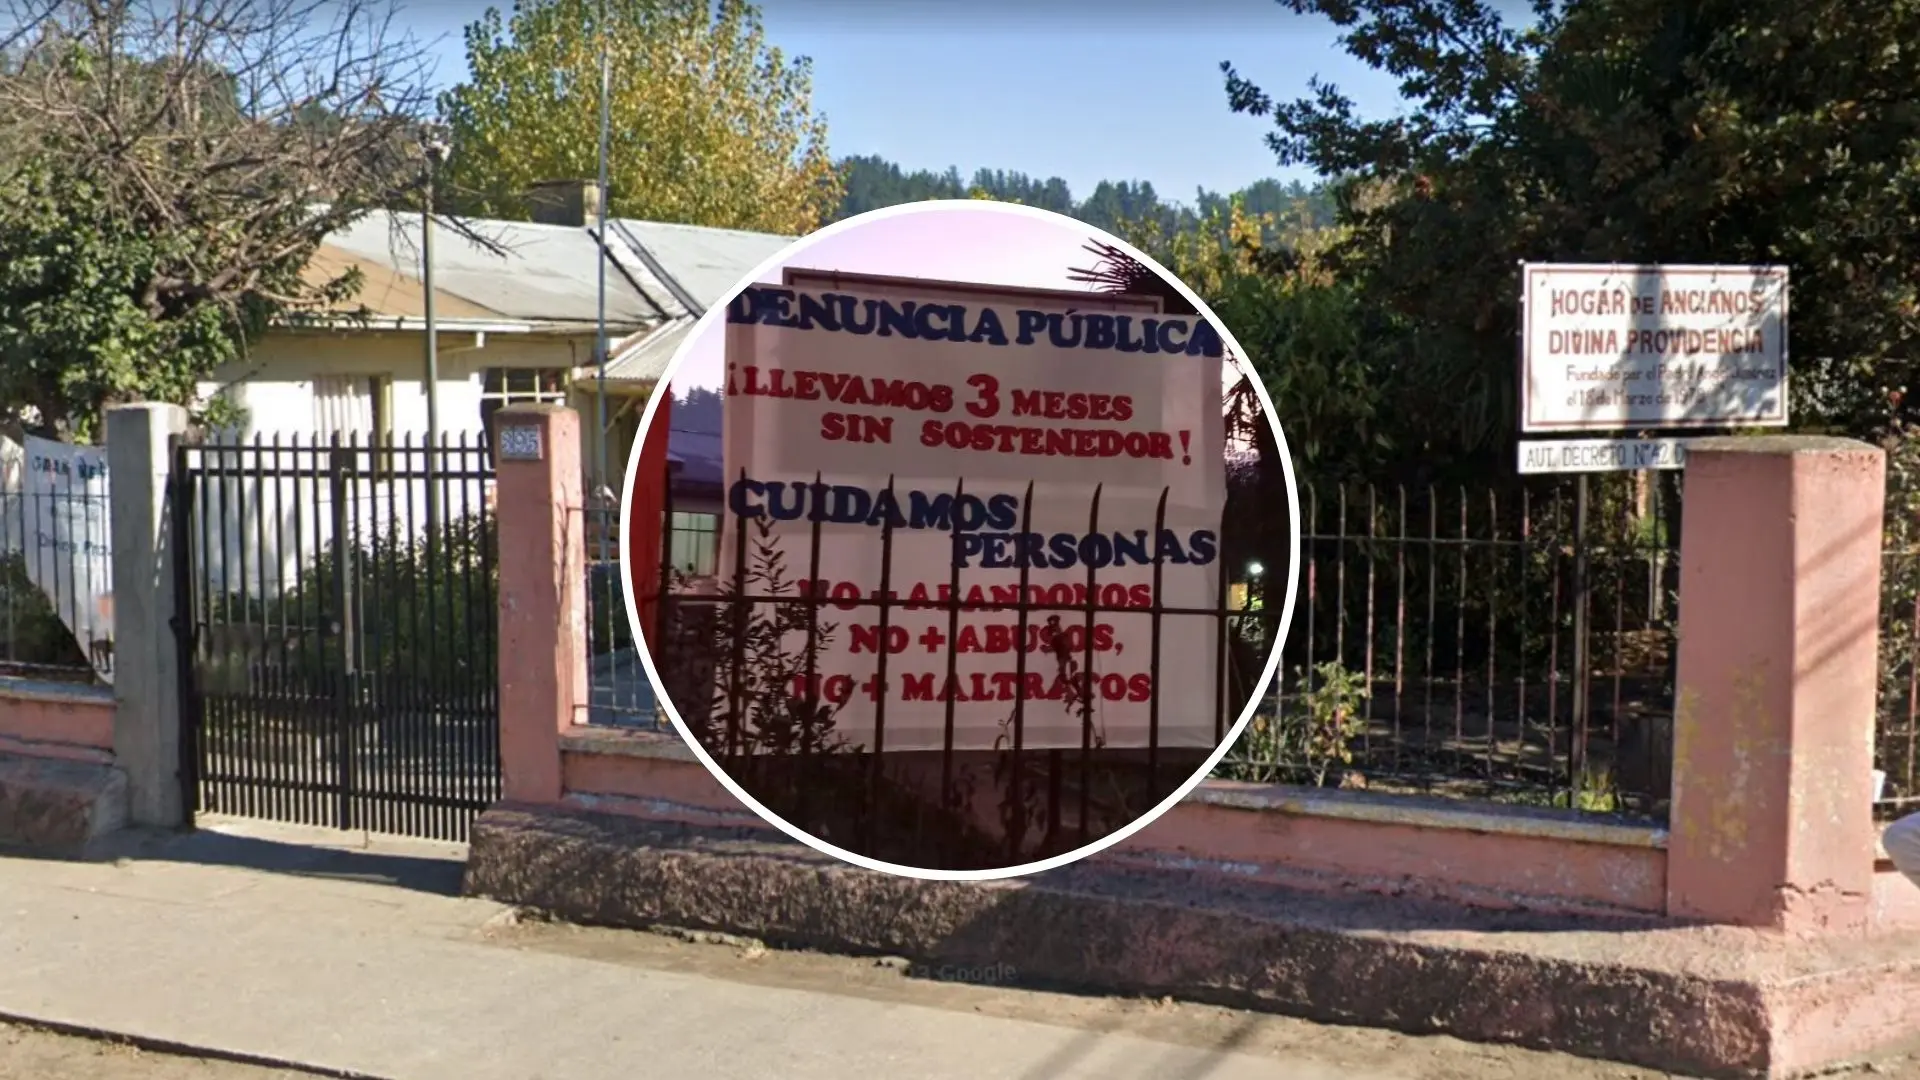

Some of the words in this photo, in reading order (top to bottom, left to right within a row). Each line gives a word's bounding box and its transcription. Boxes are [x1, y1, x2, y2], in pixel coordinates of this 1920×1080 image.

[727, 287, 1008, 345] DENUNCIA
[1016, 307, 1222, 358] PÚBLICA
[1551, 288, 1625, 317] HOGAR
[1631, 296, 1654, 315] DE
[1660, 289, 1764, 316] ANCIANOS
[1549, 329, 1618, 354] DIVINA
[1627, 328, 1764, 354] PROVIDENCIA
[965, 373, 1001, 418] 3
[1011, 389, 1133, 422] MESES
[820, 412, 893, 444] SIN
[920, 419, 1192, 466] SOSTENEDOR!
[1562, 445, 1627, 466] DECRETO
[730, 481, 1018, 530] CUIDAMOS
[951, 529, 1217, 568] PERSONAS
[848, 623, 909, 654] NO
[956, 623, 1124, 656] ABUSOS,
